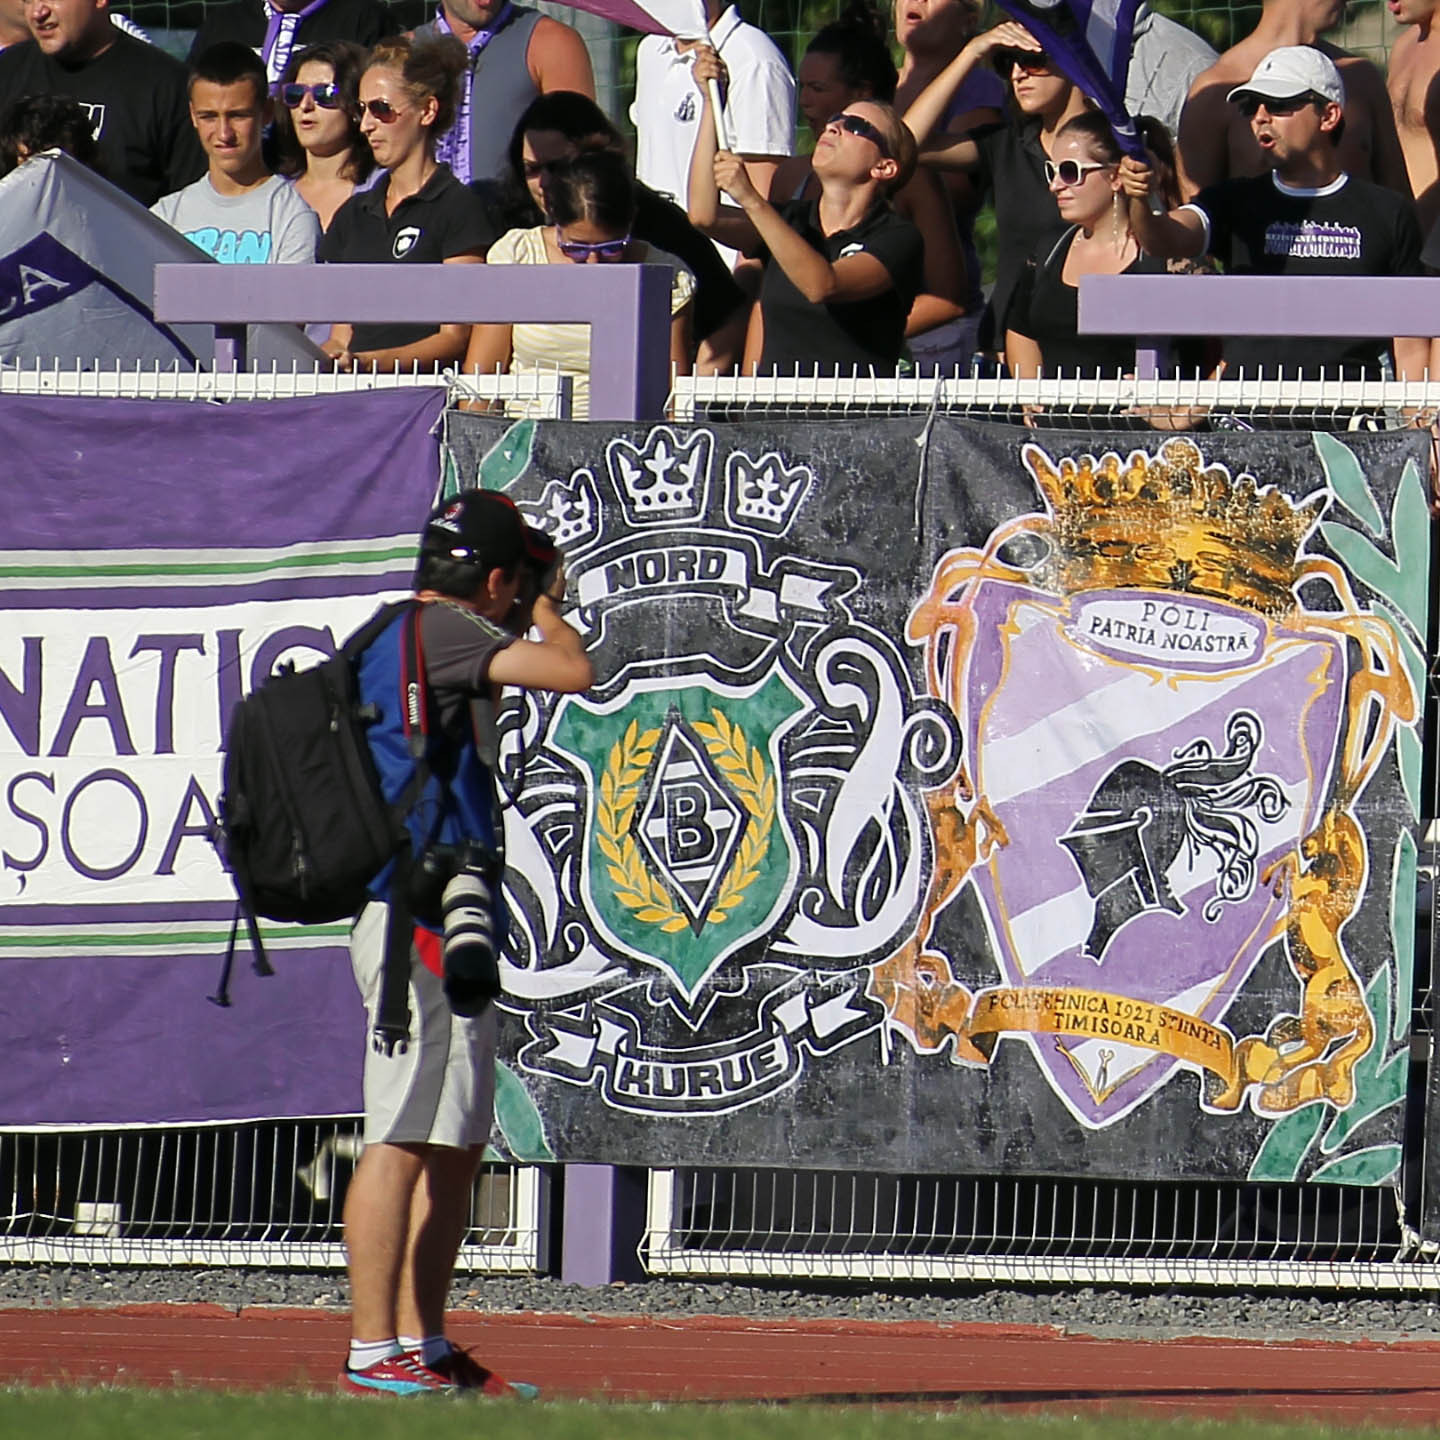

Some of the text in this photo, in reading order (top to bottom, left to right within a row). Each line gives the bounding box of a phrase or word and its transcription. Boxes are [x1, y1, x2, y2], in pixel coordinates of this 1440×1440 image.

[604, 548, 728, 594] NORD
[1088, 615, 1157, 647] PATRIA
[1141, 601, 1211, 633] POLI
[667, 791, 714, 865] B
[987, 990, 1110, 1015] POLITEHNICA
[1114, 1000, 1154, 1025] 1921
[1052, 1011, 1162, 1047] TIMISOARA
